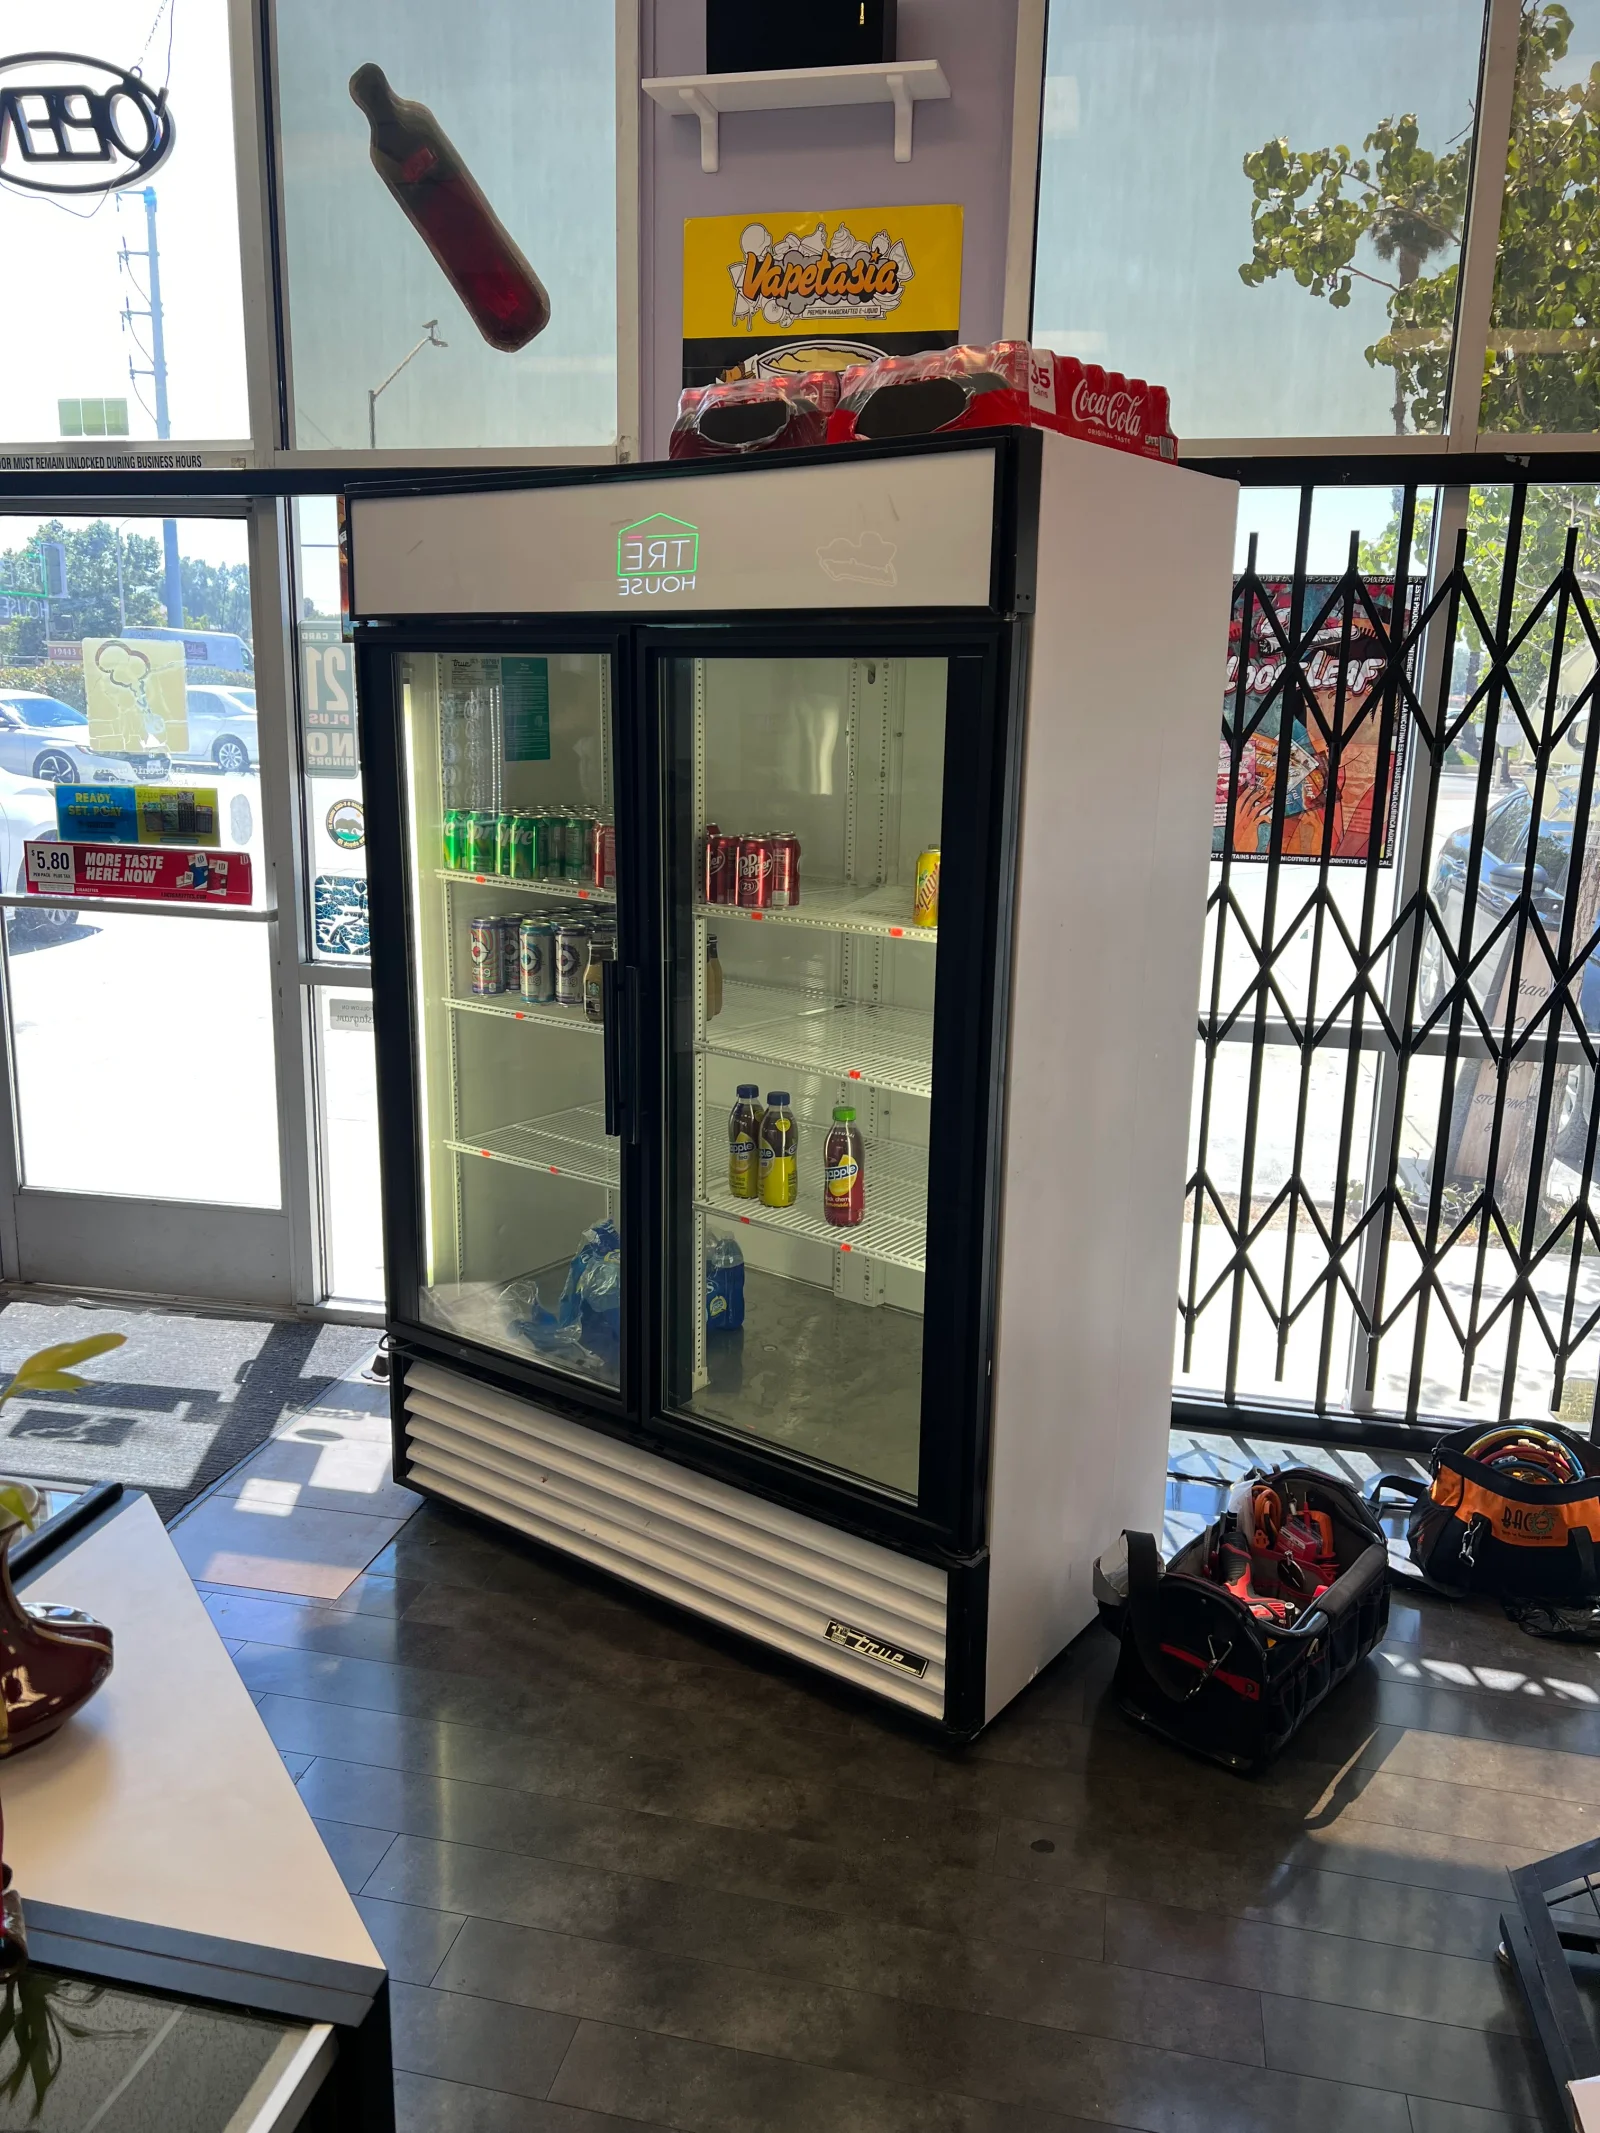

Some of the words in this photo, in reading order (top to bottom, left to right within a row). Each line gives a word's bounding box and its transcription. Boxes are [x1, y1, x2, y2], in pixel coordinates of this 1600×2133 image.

[742, 248, 899, 300] Vapetasia
[1030, 359, 1051, 389] 35
[1033, 385, 1049, 400] Cans
[1087, 428, 1113, 439] ORIGINAL
[1114, 434, 1131, 444] TASTE
[13, 457, 34, 470] MUST
[36, 457, 64, 470] REMAIN
[65, 456, 105, 469] UNLOCKED
[106, 455, 135, 469] DURING
[137, 455, 174, 468] BUSINESS
[175, 454, 202, 468] HOURS
[85, 851, 121, 867] MORE
[124, 854, 164, 870] TASTE
[739, 855, 771, 878] Pepper
[86, 866, 157, 884] HERE.NOW
[743, 882, 752, 890] 23
